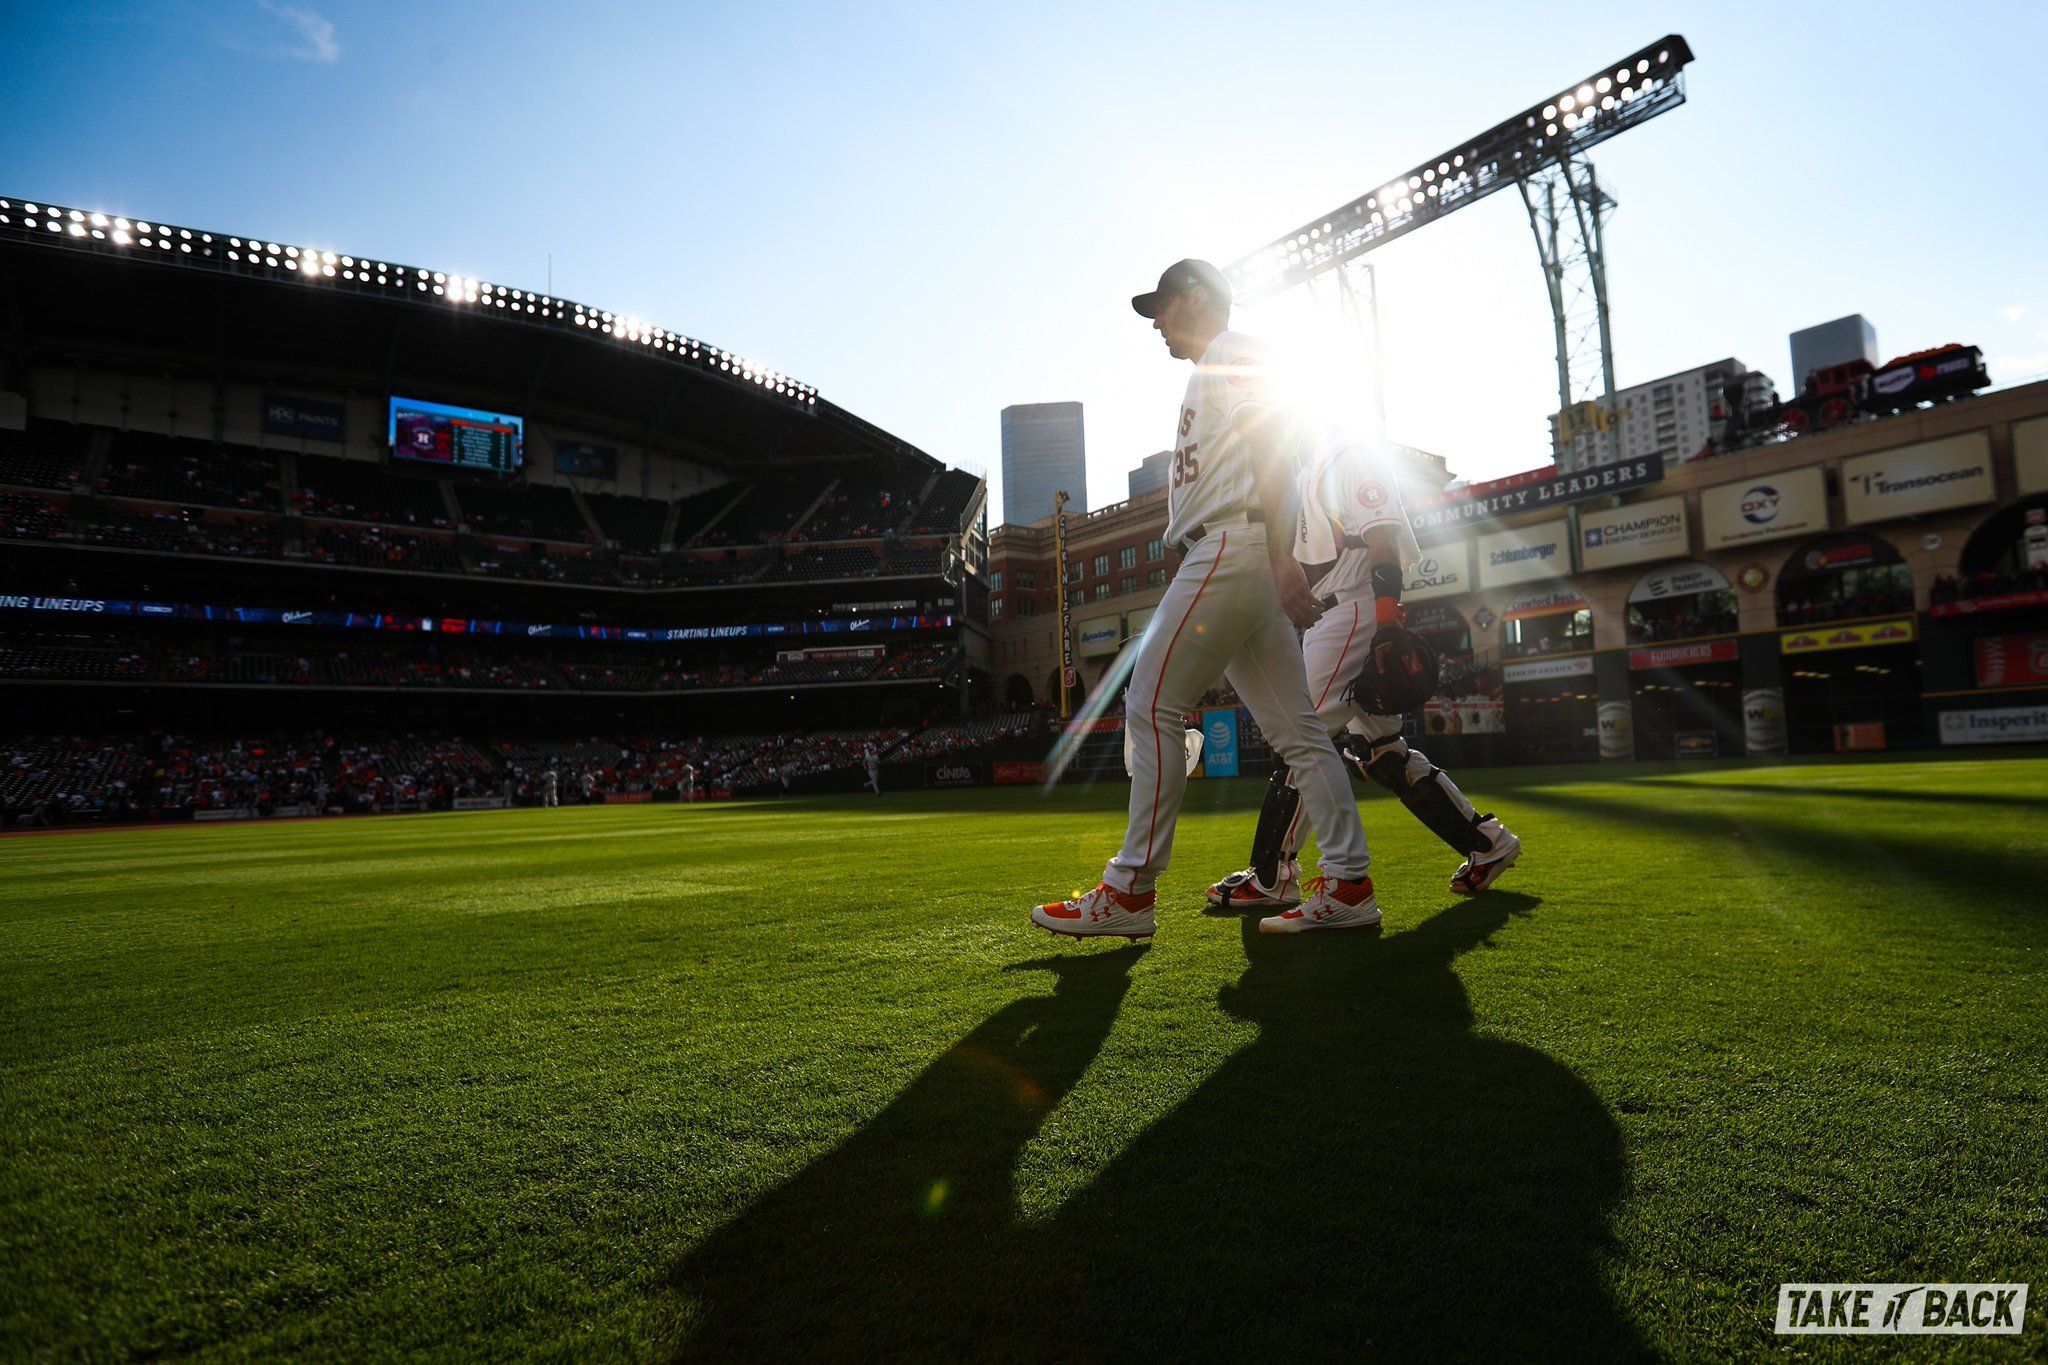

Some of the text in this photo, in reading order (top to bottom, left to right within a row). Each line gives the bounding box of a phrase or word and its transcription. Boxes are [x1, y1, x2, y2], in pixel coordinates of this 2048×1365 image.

[298, 413, 338, 427] PAINTS
[1175, 443, 1200, 489] 35
[1875, 466, 1984, 494] Transocean
[1413, 490, 1529, 529] OMMUNITY
[1539, 462, 1648, 500] LEADERS
[1741, 496, 1781, 513] OXY
[1603, 513, 1681, 537] CHAMPION
[1489, 543, 1557, 566] Schlumberger
[1402, 574, 1458, 592] LEXUS
[33, 597, 106, 613] LINEUPS
[666, 625, 748, 640] STARTING LINEUPS
[1062, 614, 1072, 665] FARE
[1209, 752, 1234, 765] AT&T
